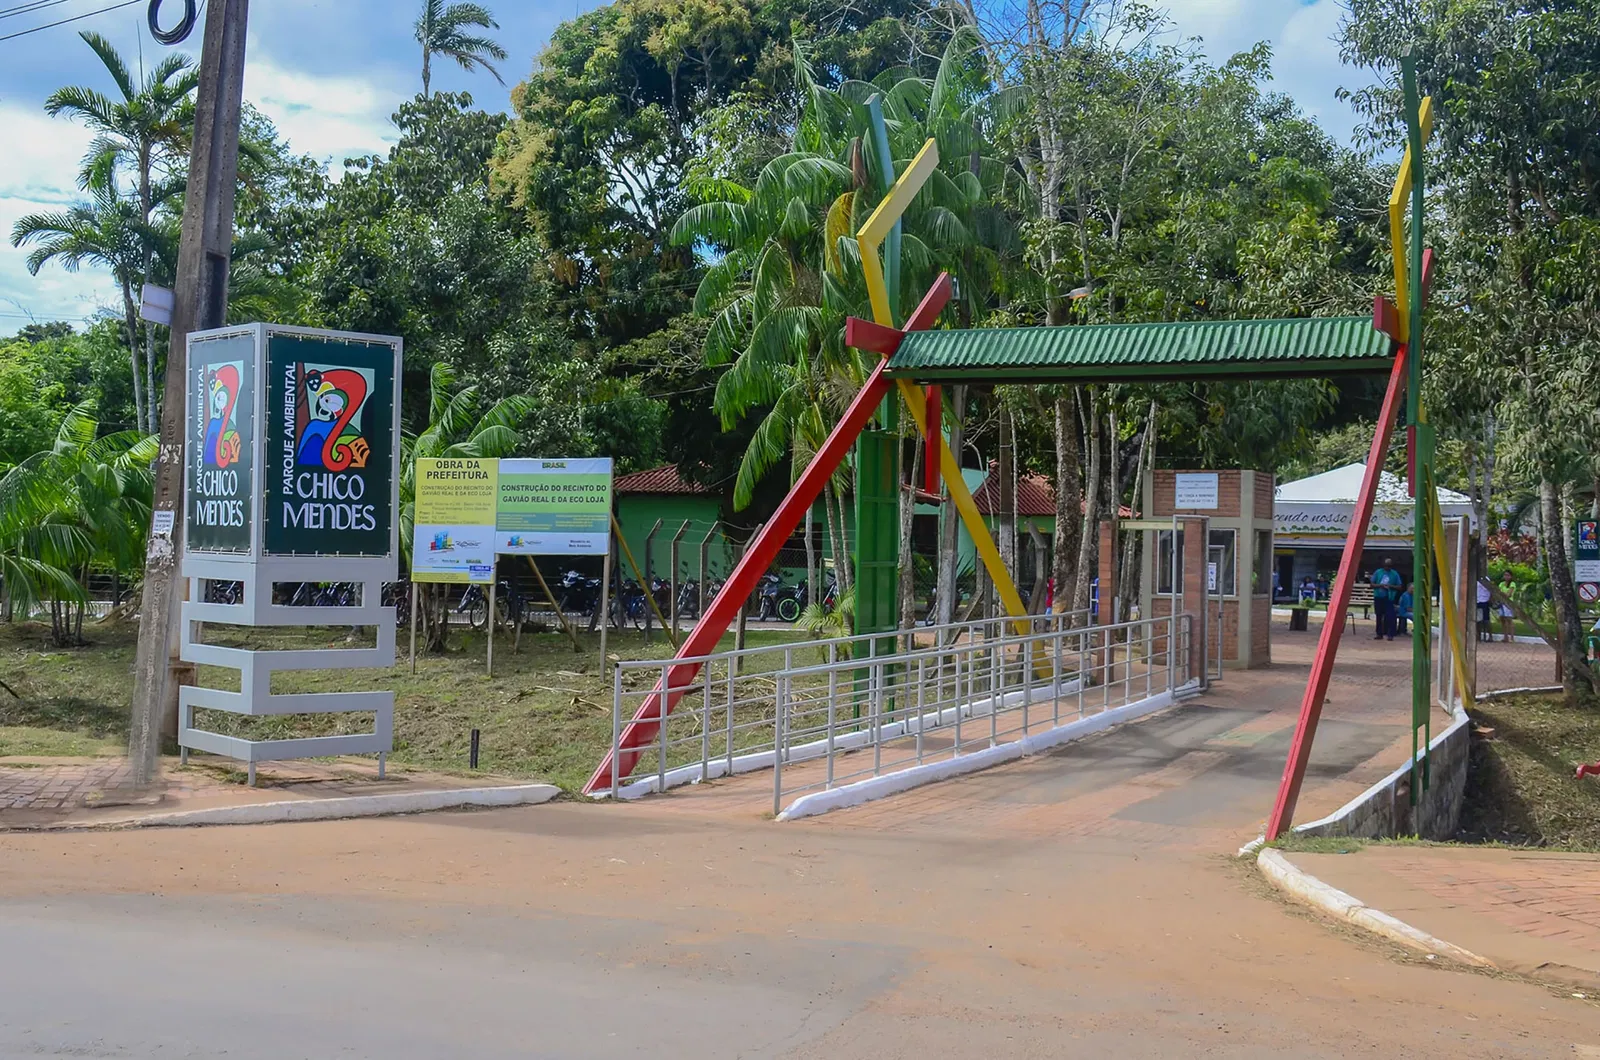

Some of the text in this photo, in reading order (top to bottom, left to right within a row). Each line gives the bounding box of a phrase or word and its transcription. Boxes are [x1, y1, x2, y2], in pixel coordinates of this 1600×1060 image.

[283, 361, 296, 495] PARQUE AMBIENTAL
[196, 440, 204, 493] PARQUE
[427, 471, 488, 480] PREFEITURA
[436, 460, 480, 469] OBRA DA
[203, 470, 238, 497] CHICO
[296, 472, 365, 500] CHICO
[501, 484, 550, 492] CONSTRUÇÃO
[196, 500, 244, 527] MENDES
[282, 501, 376, 531] MENDES
[1273, 512, 1308, 522] cendo
[1312, 514, 1348, 523] nosso
